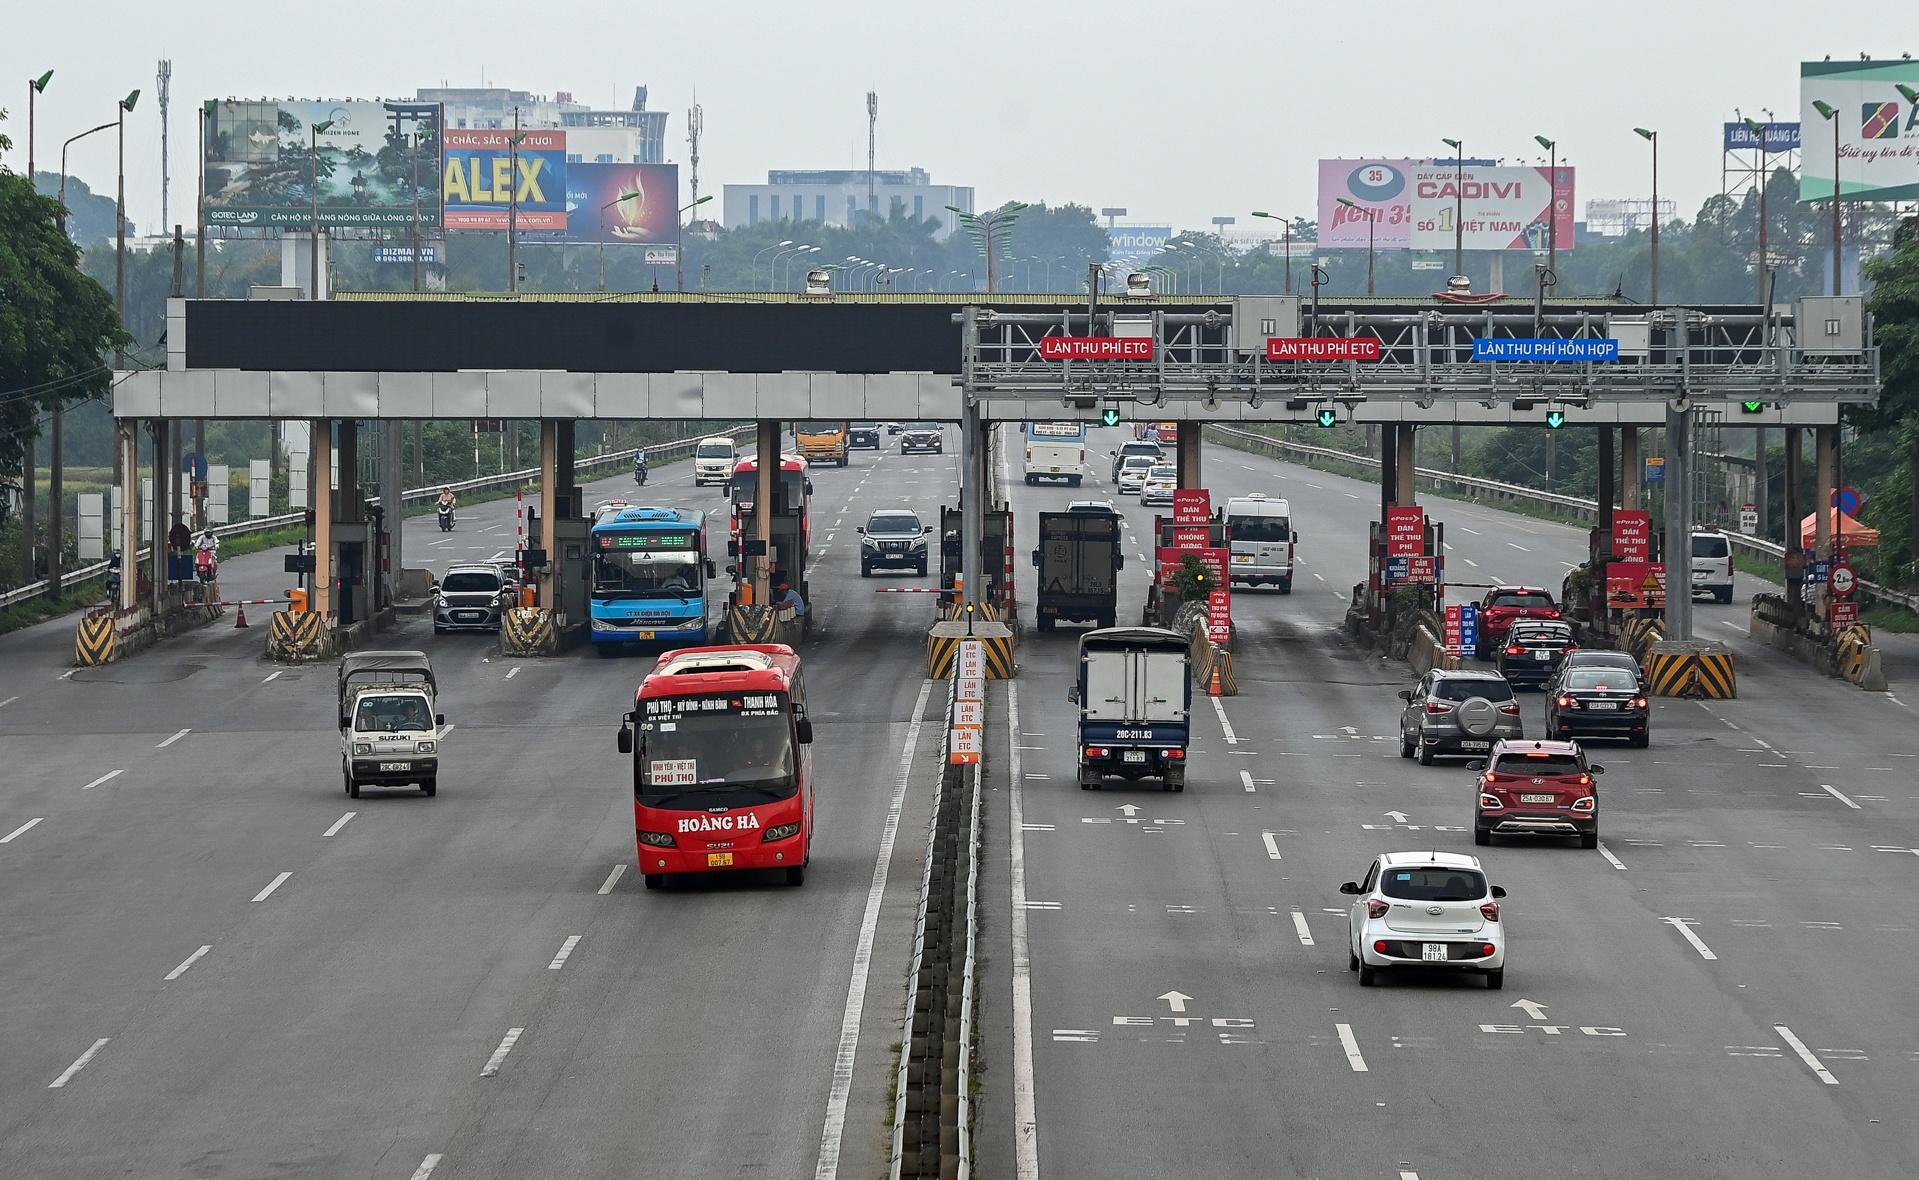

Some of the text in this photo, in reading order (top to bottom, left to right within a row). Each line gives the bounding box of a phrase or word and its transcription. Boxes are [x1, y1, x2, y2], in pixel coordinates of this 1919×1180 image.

[1368, 170, 1383, 181] 35
[444, 157, 547, 204] ALEX
[1417, 182, 1521, 199] CADIVI
[211, 211, 259, 219] GOTEC LAND
[430, 213, 435, 221] 7
[1417, 217, 1435, 232] SỐ
[1438, 206, 1454, 232] 1
[1489, 221, 1521, 232] NAM
[1046, 339, 1148, 354] LÀN THU PHÍ ETC
[1272, 340, 1375, 355] LÀN THU PHÍ ETC
[1478, 339, 1614, 358] LÀN THU PHÍ HỖN HỢP
[1192, 515, 1207, 523] THU
[1178, 532, 1205, 541] KHÔNG
[1399, 542, 1413, 550] PHÍ
[1623, 545, 1638, 554] PHÍ
[965, 651, 977, 659] ETC
[965, 660, 977, 668] LÀN
[965, 669, 977, 677] ETC
[964, 681, 977, 689] LÀN
[964, 690, 976, 698] ETC
[743, 695, 764, 708] THANH
[646, 700, 659, 714] PHÚ
[961, 704, 974, 713] LÀN
[958, 730, 972, 740] LÀN
[1116, 730, 1153, 739] 20C-211.83
[958, 741, 972, 750] ETC
[654, 772, 694, 784] PHÚ THỌ
[678, 813, 734, 833] HOÀNG
[1428, 943, 1442, 953] 98A
